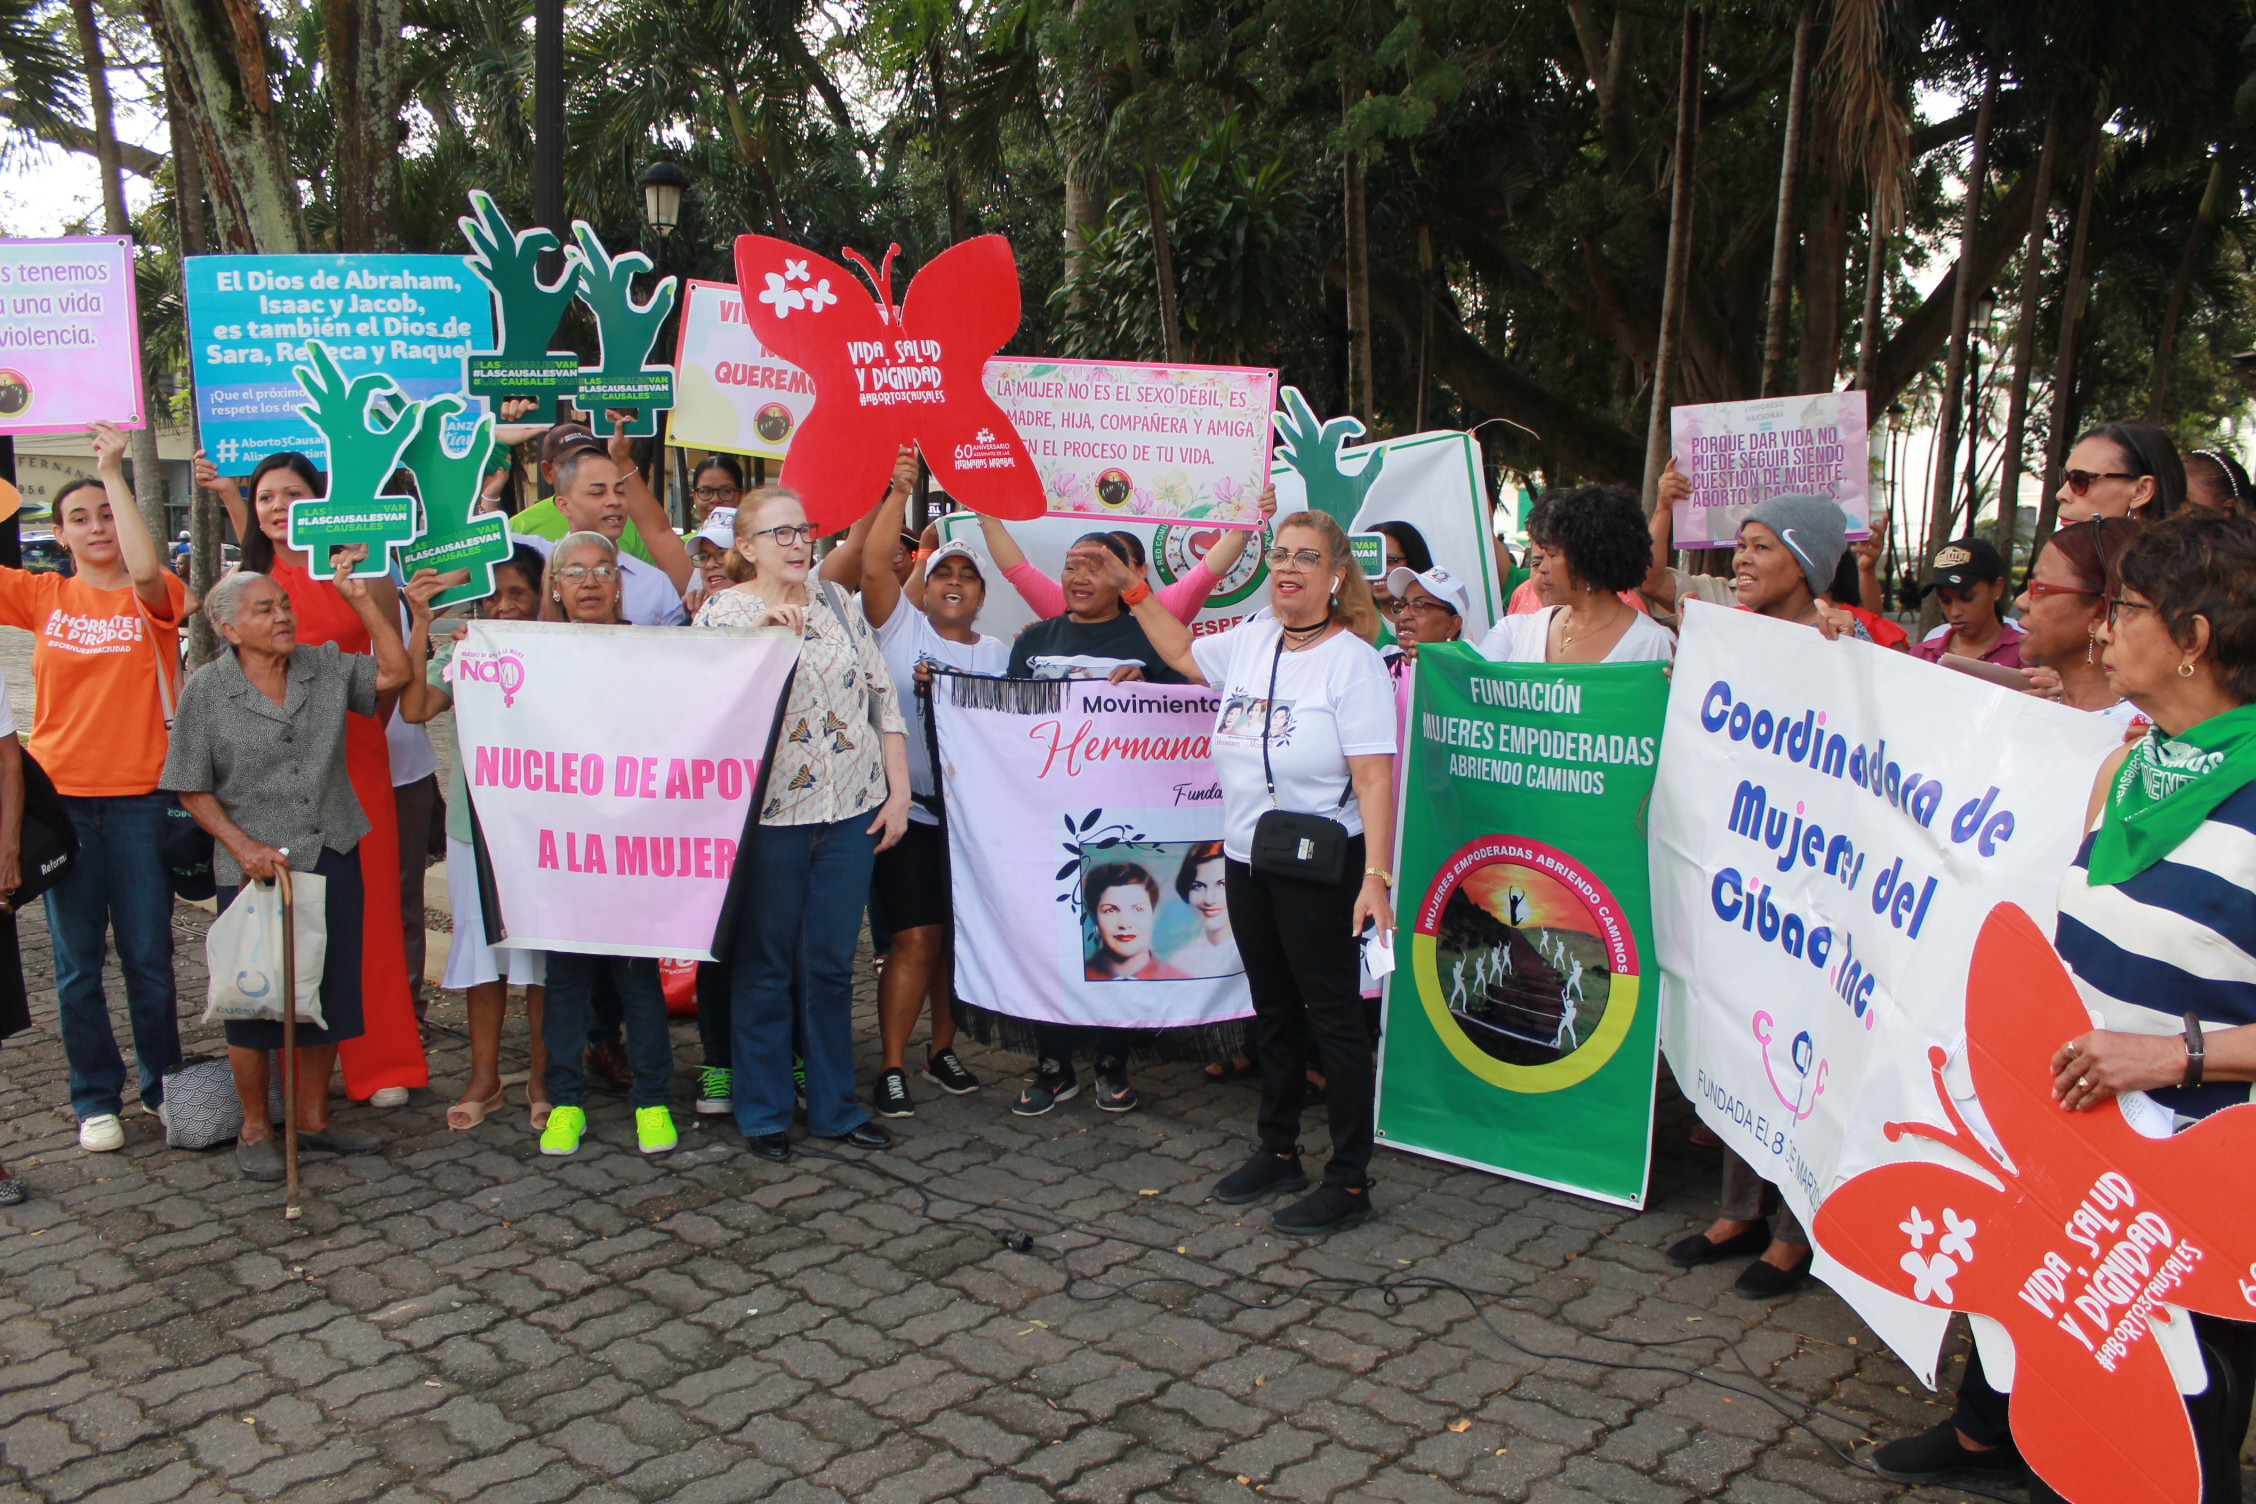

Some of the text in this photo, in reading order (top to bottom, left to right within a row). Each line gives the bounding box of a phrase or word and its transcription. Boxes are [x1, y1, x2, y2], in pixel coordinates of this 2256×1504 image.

[17, 264, 108, 281] tenemos
[216, 269, 462, 293] El Dios de Abraham,
[13, 297, 51, 314] una
[58, 293, 101, 313] vida
[260, 292, 426, 318] Isaac y Jacob,
[213, 316, 472, 339] es también el Dios de
[206, 339, 473, 366] Sara, Reeca y Raquel
[846, 339, 942, 366] VIDA, SALUD
[473, 369, 578, 378] #LASCAUSALESVAN
[854, 365, 942, 391] Y DIGNIDAD
[211, 390, 240, 404] ¡Que
[242, 388, 254, 399] el
[578, 384, 669, 393] #LASCAUSALESVAN
[859, 390, 946, 407] #ABORTO3CAUSALES
[997, 380, 1247, 409] LA MUJER NO ES EL SEXO DÉBIL, ES
[211, 404, 259, 417] respete
[261, 402, 280, 413] los
[1007, 409, 1255, 438] MADRE, HIJA, COMPAÑERA Y AMIGA
[954, 443, 973, 459] 60
[1043, 440, 1058, 456] EL
[1063, 441, 1128, 460] PROCESO
[1133, 445, 1151, 461] DE
[1156, 445, 1174, 463] TU
[1180, 447, 1215, 465] VIDA.
[1691, 427, 1838, 454] PORQUE DAR VIDA NO
[1692, 444, 1844, 472] PUEDE SEGUIR SIENDO
[18, 484, 45, 495] 956
[1692, 463, 1847, 490] CUESTION DE MUERTE,
[1693, 487, 1747, 508] ABORTO
[1751, 486, 1760, 505] 3
[297, 512, 407, 526] #LASCAUSALESVAN
[404, 531, 502, 564] #LASCAUSALESVAN
[1155, 548, 1164, 566] RED
[45, 622, 64, 638] EL
[50, 608, 134, 634] AHÓRRATE
[48, 640, 132, 655] #PORNUESTRACIUDAD
[1082, 693, 1221, 714] Movimiento
[1470, 676, 1582, 715] FUNDACIÓN
[1029, 719, 1212, 779] Hermana
[1422, 711, 1655, 767] MUJERES EMPODERADAS
[475, 745, 605, 796] NUCLEO
[614, 755, 659, 799] DE
[1449, 753, 1605, 795] ABRIENDO CAMINOS
[1700, 680, 2016, 858] Coordinadora de
[1172, 781, 1224, 807] Funda
[538, 829, 739, 880] A LA MUJER
[1727, 779, 1940, 940] Mujeres del
[1425, 845, 1628, 974] MUJERES EMPODERADAS ABRIENDO CAMINOS
[1698, 1068, 1754, 1134] FUNDADA
[1755, 1115, 1771, 1148] EL
[1772, 1131, 1785, 1155] 8
[2063, 1171, 2136, 1260] SALUD
[2057, 1210, 2172, 1352] Y DIGNIDAD
[2093, 1238, 2203, 1373] #ABORTO3CAUSALES
